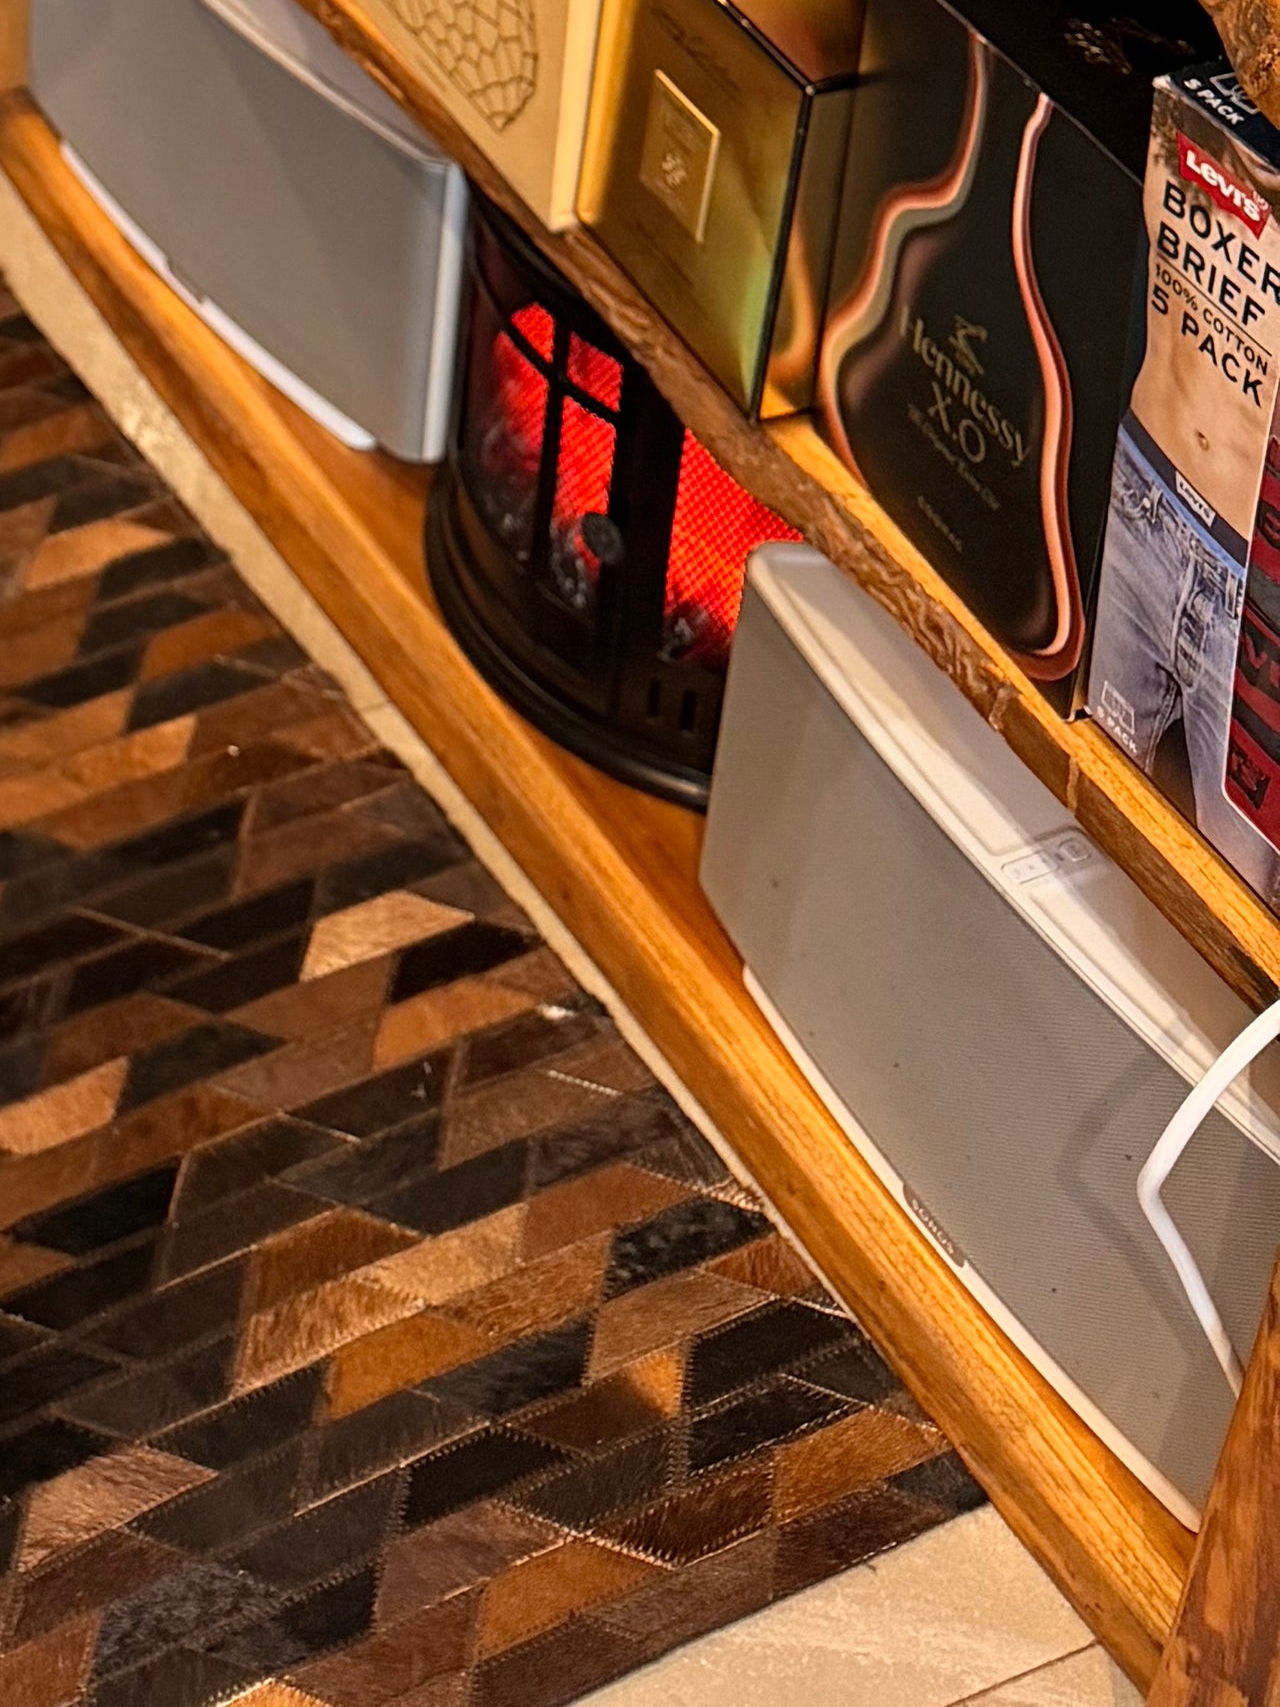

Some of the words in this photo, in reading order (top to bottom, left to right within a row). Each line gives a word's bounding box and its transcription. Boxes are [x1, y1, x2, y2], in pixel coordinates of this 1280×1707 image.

[1197, 89, 1245, 126] PACK
[1157, 221, 1266, 327] BRIEF
[1162, 178, 1280, 307] BOXER
[1151, 284, 1170, 316] 5
[1181, 310, 1264, 408] PACK
[1155, 263, 1199, 312] 100%
[1203, 307, 1269, 376] COTTON
[899, 305, 1033, 468] Hennessy
